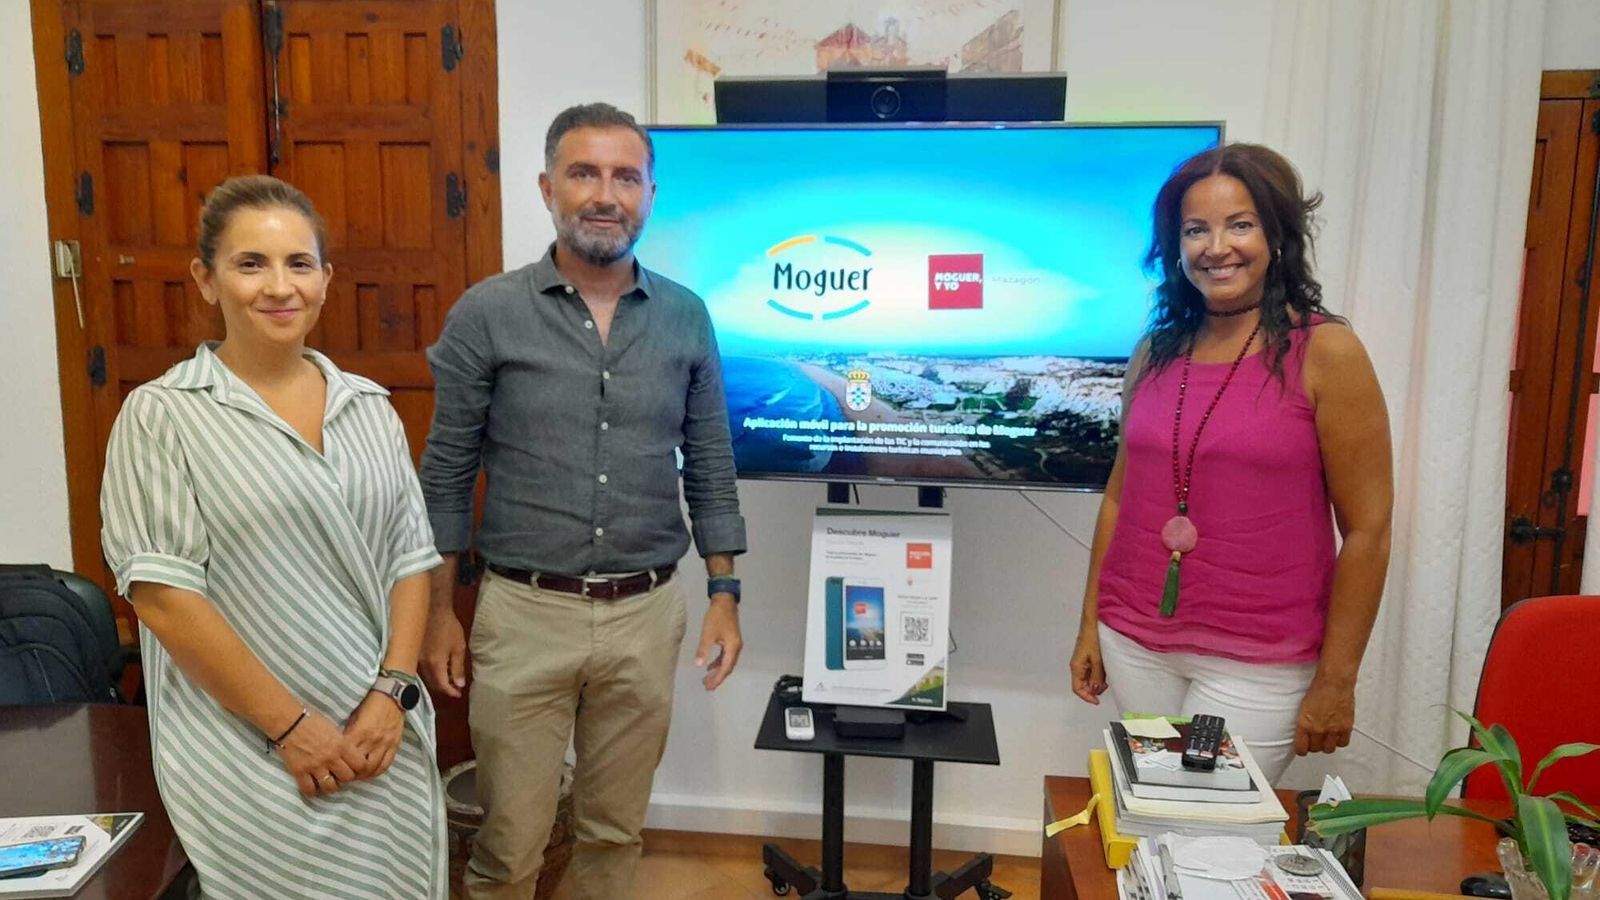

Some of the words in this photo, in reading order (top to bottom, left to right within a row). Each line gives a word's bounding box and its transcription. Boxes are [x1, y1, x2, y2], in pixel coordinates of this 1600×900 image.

[773, 262, 873, 297] Moguer
[935, 272, 982, 285] MOGUER,
[935, 281, 942, 291] Y
[943, 281, 960, 291] YO
[743, 417, 798, 430] Aplicación
[799, 419, 829, 429] móvil
[830, 421, 855, 432] para
[856, 420, 867, 431] la
[868, 422, 927, 434] promoción
[929, 423, 976, 435] turística
[977, 424, 992, 435] de
[993, 424, 1037, 438] Moguer
[813, 435, 822, 443] de
[827, 527, 867, 537] Descubre
[869, 529, 900, 538] Moguer
